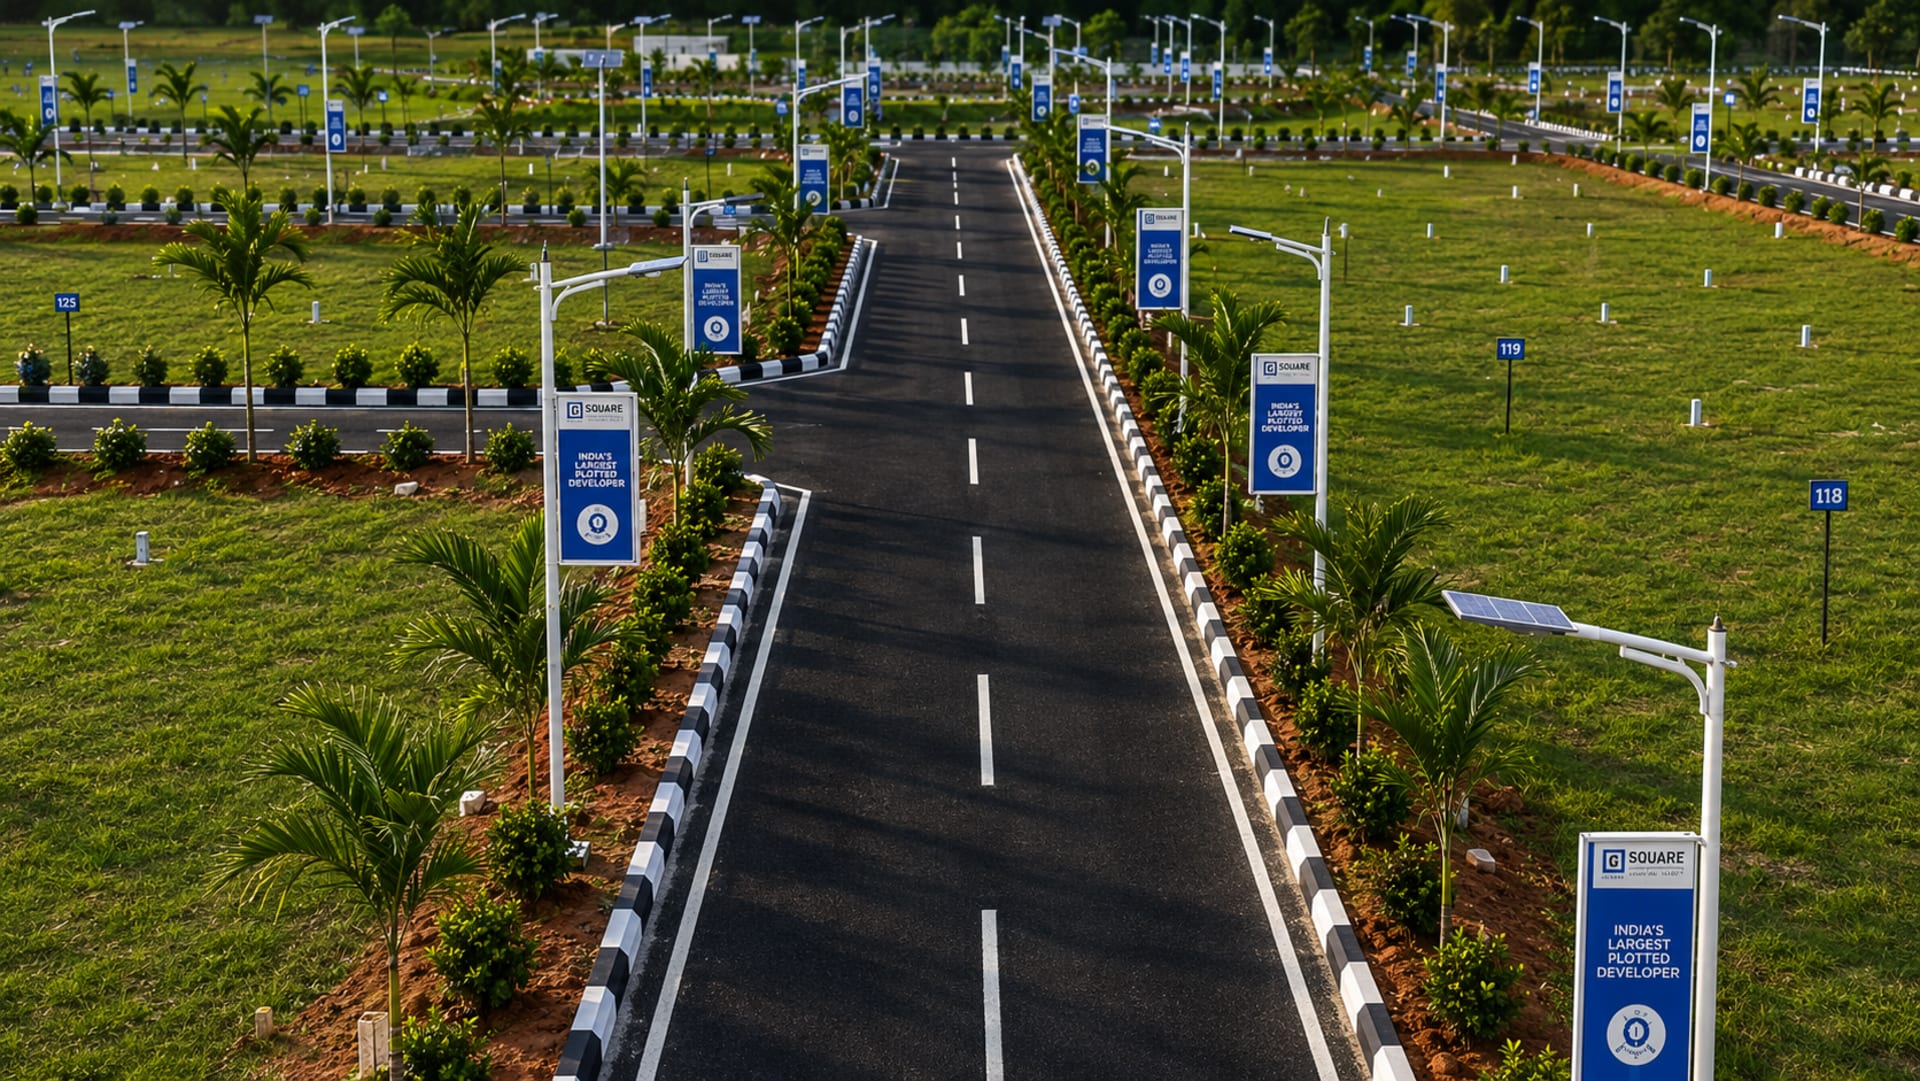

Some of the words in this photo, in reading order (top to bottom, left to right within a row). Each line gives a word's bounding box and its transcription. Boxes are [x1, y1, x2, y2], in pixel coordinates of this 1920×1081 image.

[57, 297, 76, 308] 125
[1500, 343, 1521, 355] 119
[585, 404, 624, 413] SQUARE
[578, 452, 612, 461] INDIA'S
[575, 470, 617, 478] PLOTTED
[568, 479, 625, 488] DEVELOPER
[1815, 487, 1843, 504] 118
[1628, 851, 1685, 864] SQUARE
[1614, 924, 1664, 936] INDIA'S
[1608, 938, 1671, 951] LARGEST
[1608, 952, 1671, 964] PLOTTED
[1596, 966, 1680, 979] DEVELOPER
